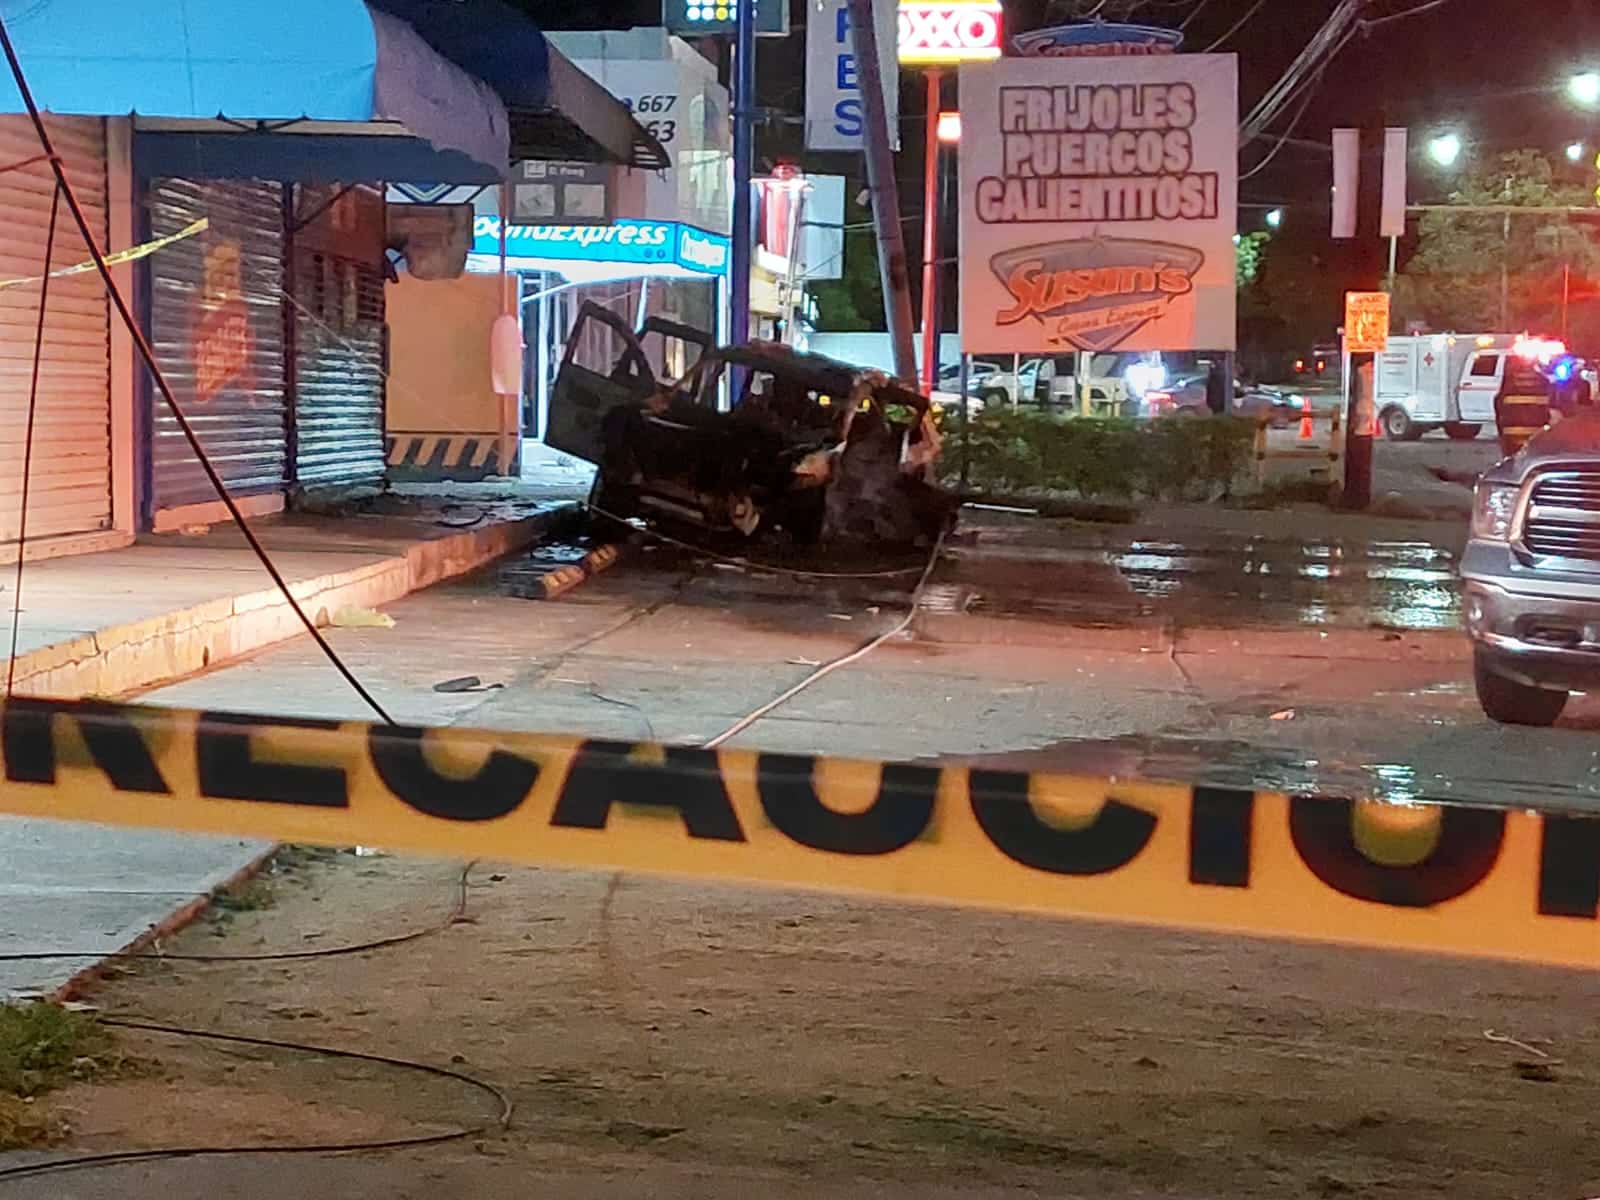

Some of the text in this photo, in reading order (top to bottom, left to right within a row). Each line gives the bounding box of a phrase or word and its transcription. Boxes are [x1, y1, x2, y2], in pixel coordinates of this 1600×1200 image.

[638, 95, 677, 112] 667
[1000, 82, 1197, 135] FRIJOLES
[1003, 129, 1193, 178] PUERCOS
[995, 258, 1193, 325] Susan's
